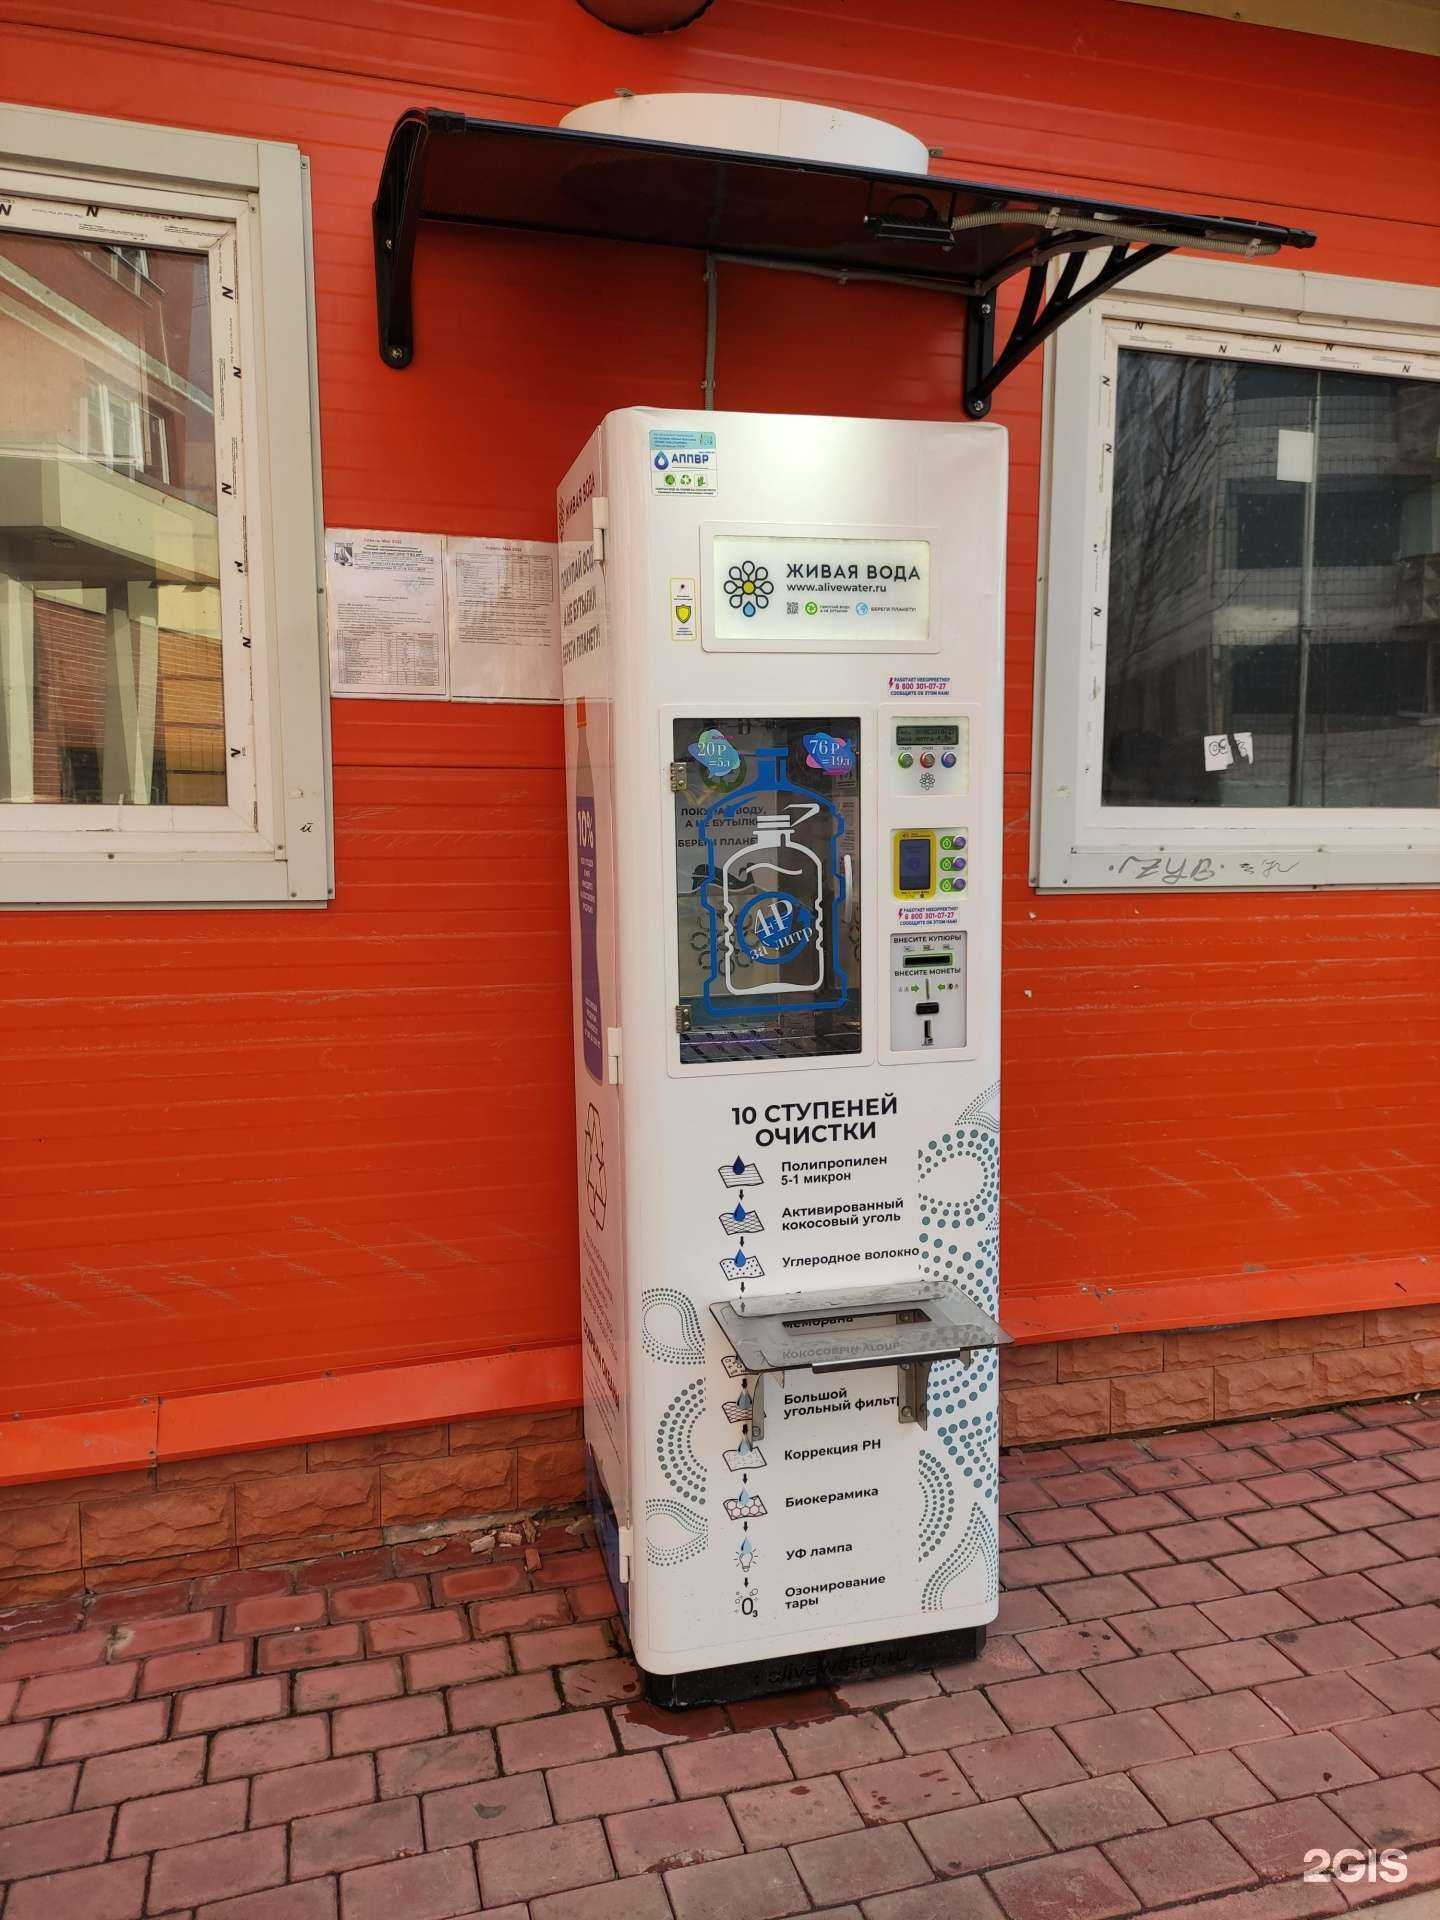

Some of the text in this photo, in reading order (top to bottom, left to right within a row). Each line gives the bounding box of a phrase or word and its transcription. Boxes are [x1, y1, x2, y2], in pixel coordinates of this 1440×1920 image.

[672, 453, 709, 464] АППВР
[786, 563, 921, 582] ЖИВАЯ ВОДА
[786, 582, 887, 593] www.alivewater.ru
[712, 817, 758, 827] БУТЫЛК
[893, 934, 962, 944] ВНЕСИТЕ КУПЮРЫ
[929, 967, 961, 975] МОНЕТЫ
[732, 1093, 898, 1125] 10 СТУПЕНЕЙ
[755, 1122, 877, 1147] ОЧИСТКИ
[781, 1155, 888, 1174] Полипропилен
[781, 1171, 852, 1186] 5-1 микрон
[782, 1198, 904, 1218] Активированный
[782, 1213, 901, 1231] кокосовый уголь
[782, 1247, 920, 1269] Углеродное волокно
[784, 1388, 848, 1405] Большой
[784, 1401, 851, 1420] угольный
[784, 1443, 858, 1461] Коррекция
[785, 1487, 879, 1508] Биокерамика
[786, 1543, 853, 1561] УФ лампа
[785, 1574, 886, 1597] Озонирование
[785, 1597, 819, 1611] тары
